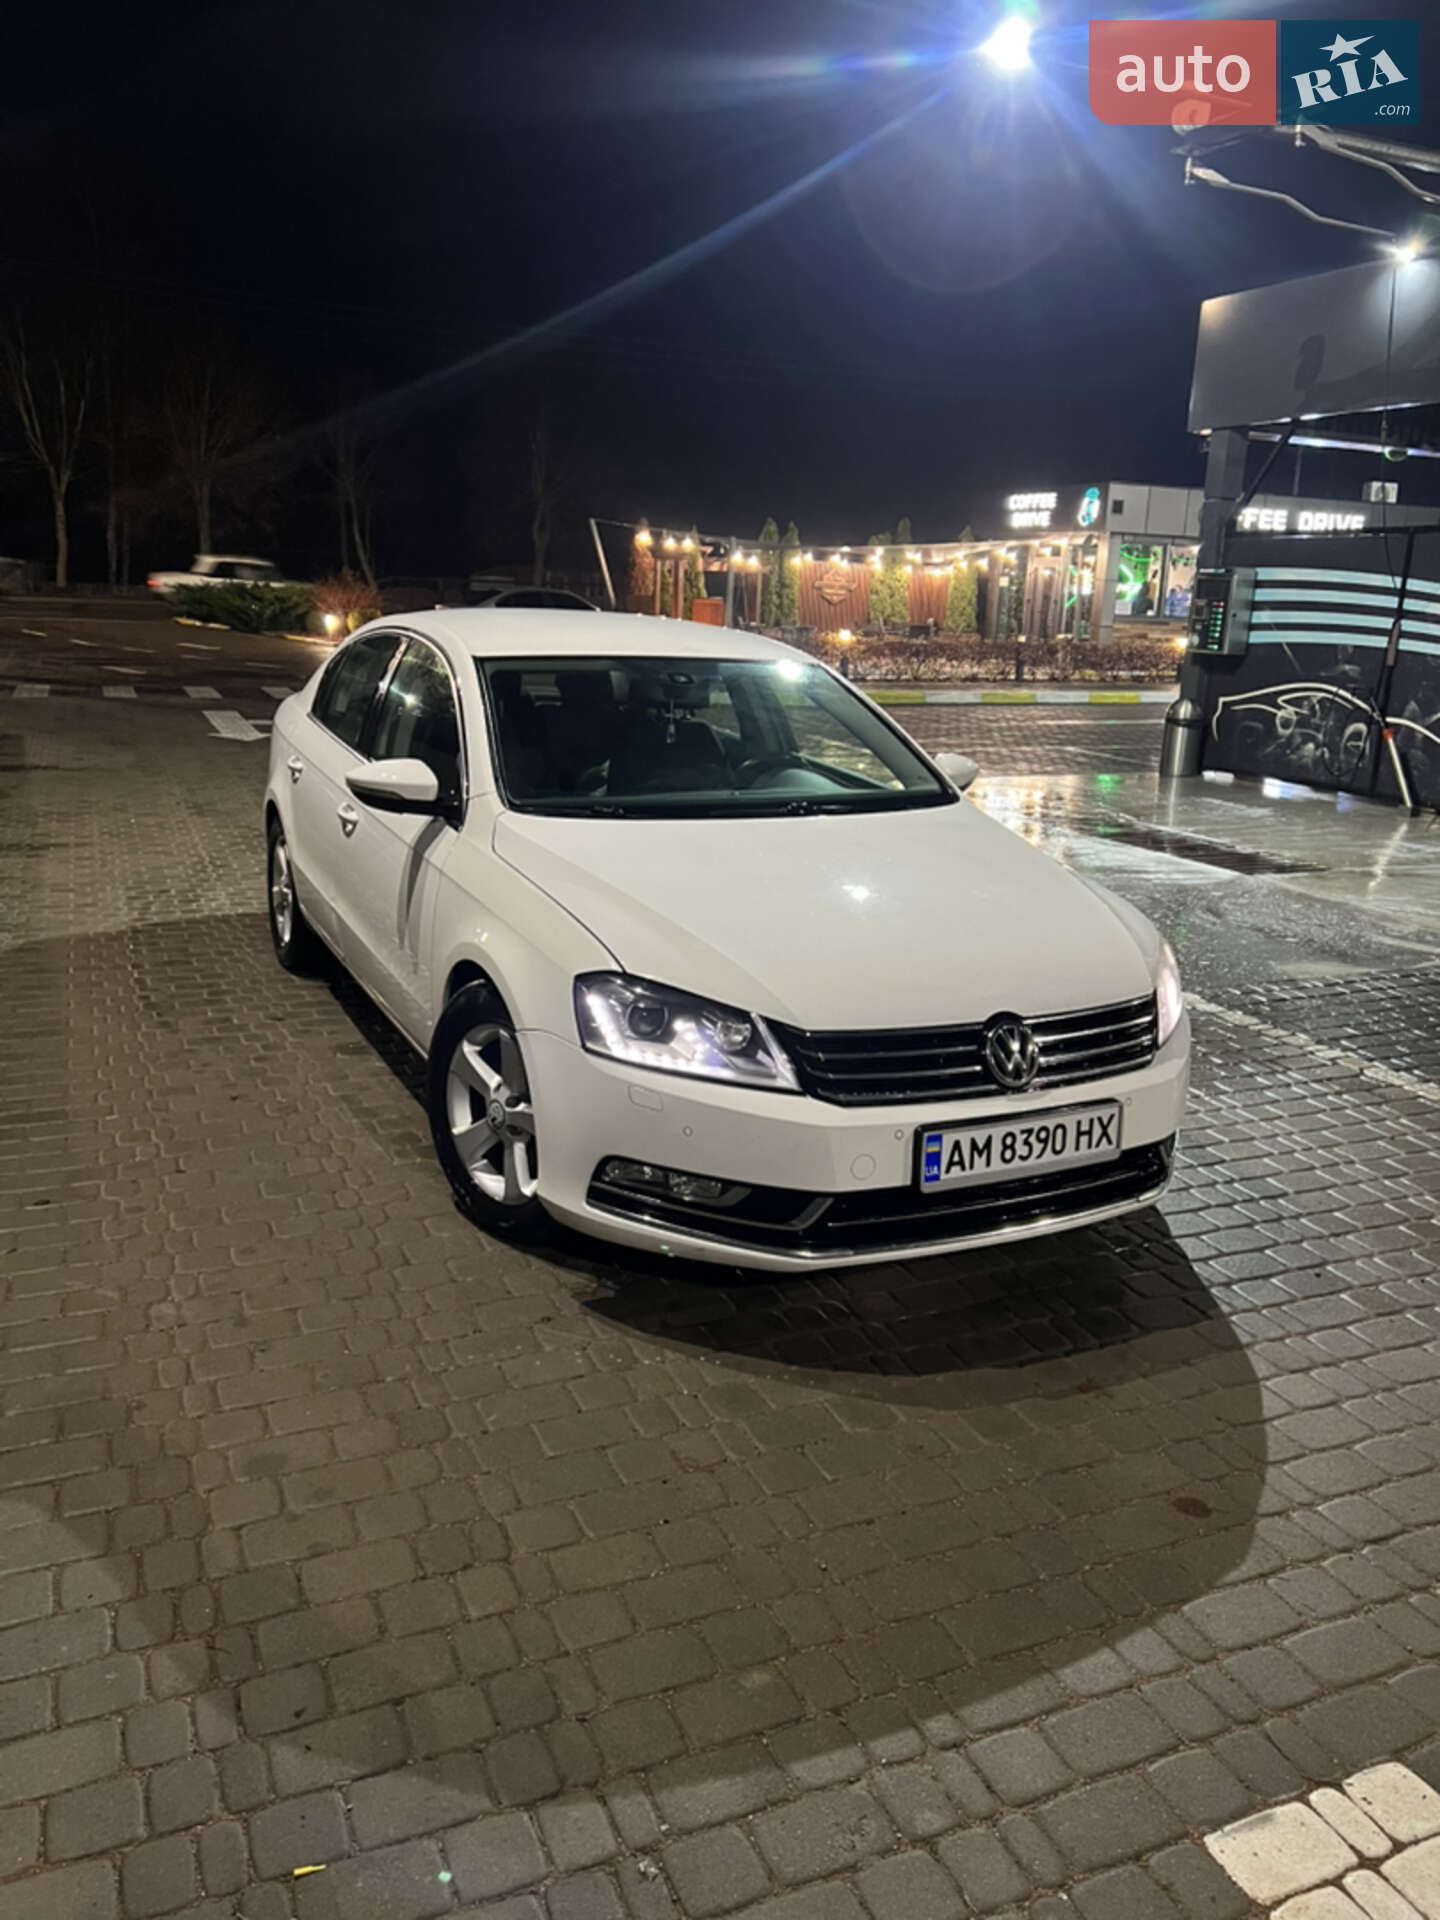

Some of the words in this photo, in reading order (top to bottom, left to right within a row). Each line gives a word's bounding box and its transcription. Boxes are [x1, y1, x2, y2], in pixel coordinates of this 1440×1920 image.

[1237, 507, 1288, 531] FEE
[1298, 511, 1365, 531] DRIVE
[945, 1134, 993, 1174] AM
[1000, 1123, 1067, 1164] 8390
[1075, 1113, 1115, 1152] HX
